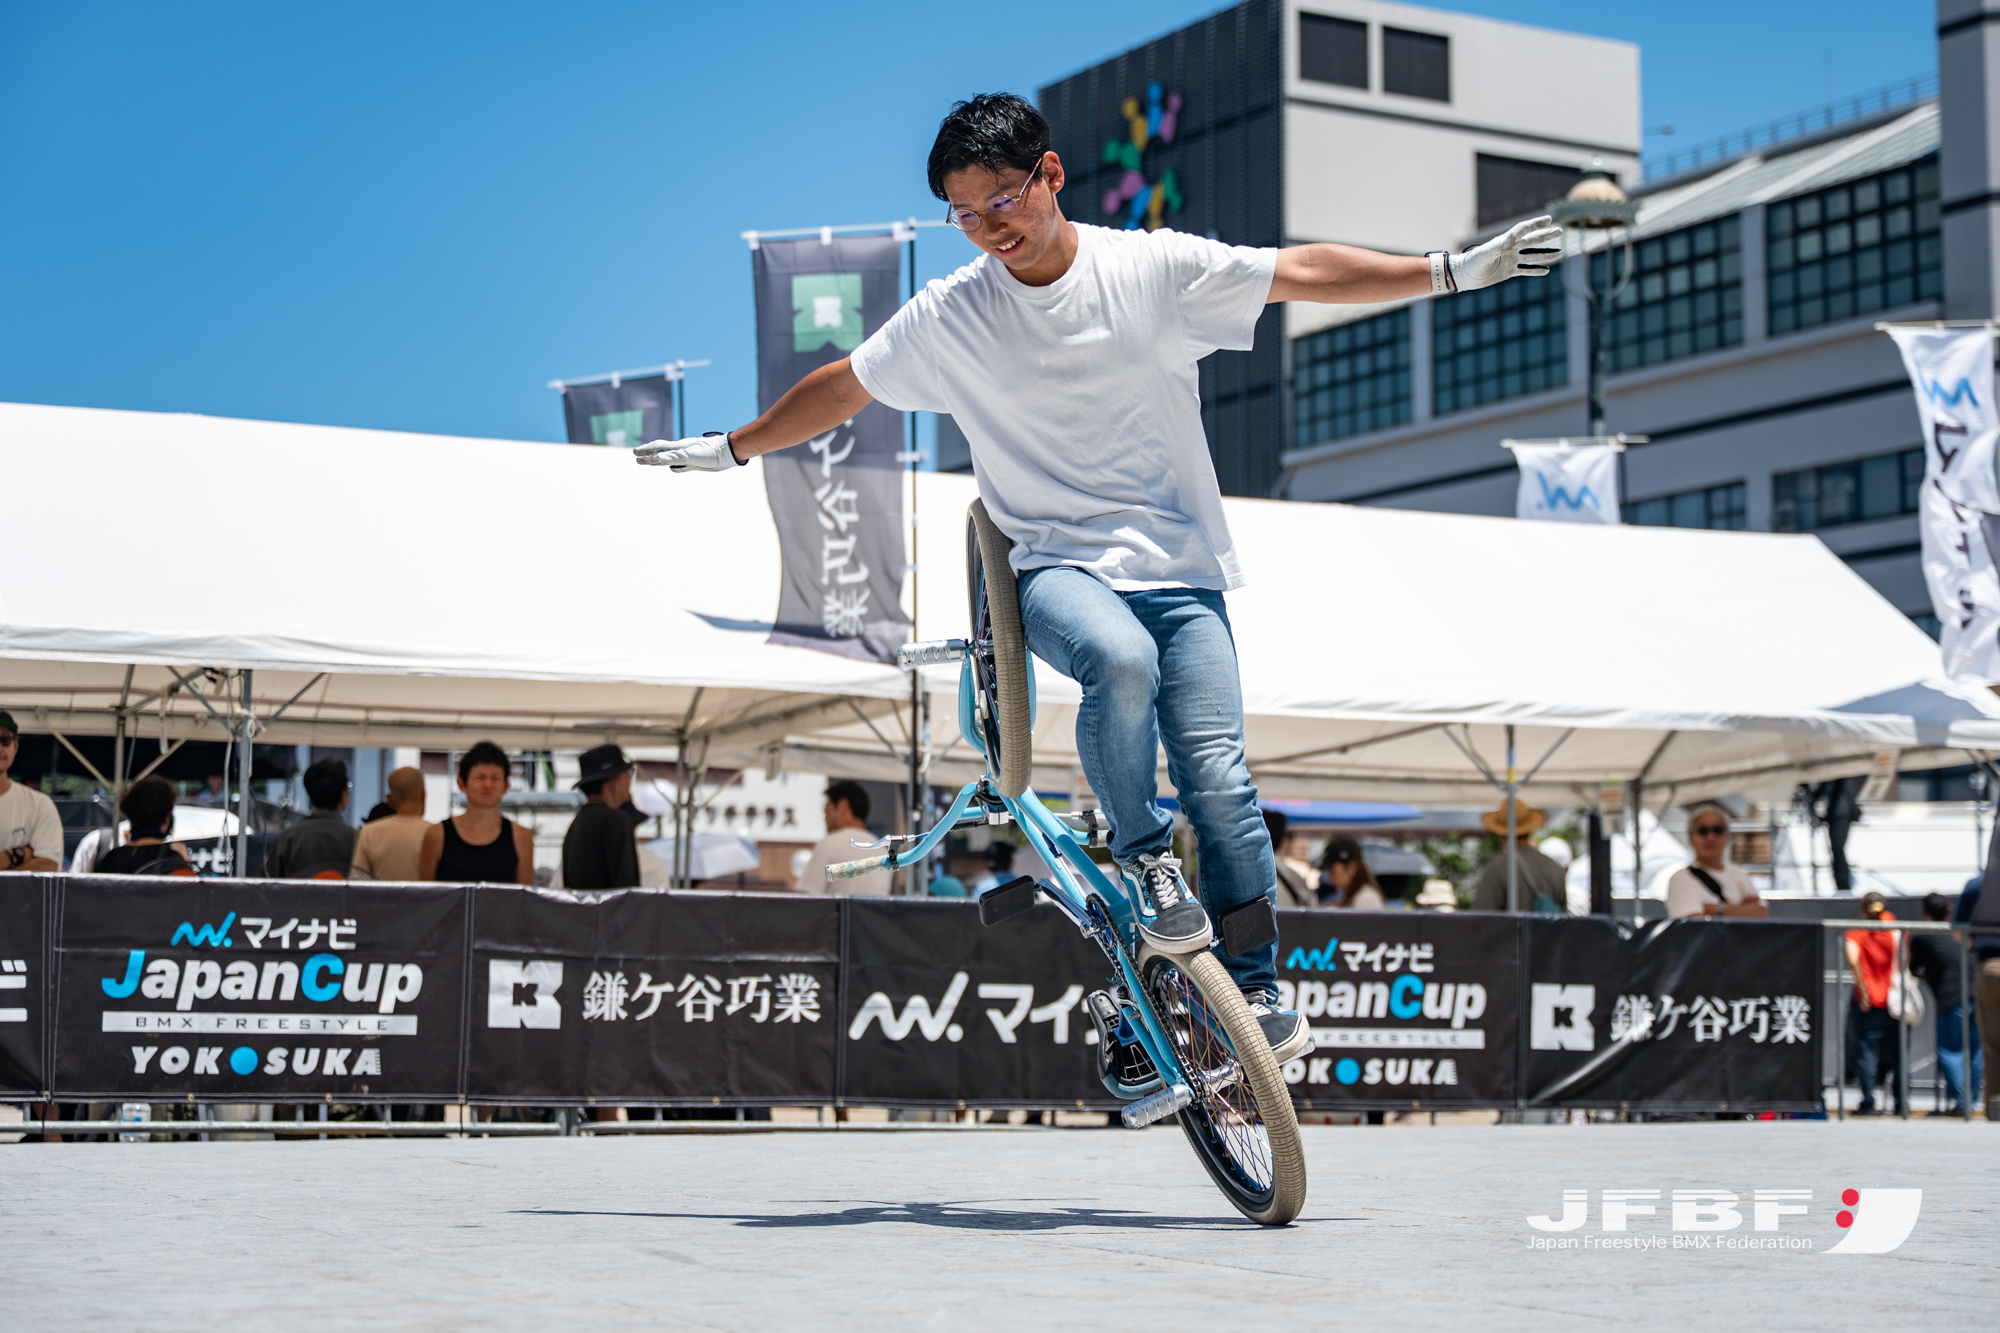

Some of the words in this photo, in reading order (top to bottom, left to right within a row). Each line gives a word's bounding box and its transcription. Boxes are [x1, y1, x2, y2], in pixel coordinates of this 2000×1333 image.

[241, 917, 357, 950] マイナビ
[1339, 941, 1435, 974] マイナビ
[101, 949, 424, 1013] JapanCup
[582, 970, 822, 1024] 鎌ケ谷巧業
[1278, 974, 1487, 1030] apanCup
[136, 1017, 193, 1029] BMX
[217, 1018, 388, 1031] FREESTYLE
[1324, 1034, 1459, 1047] FREESTYLE
